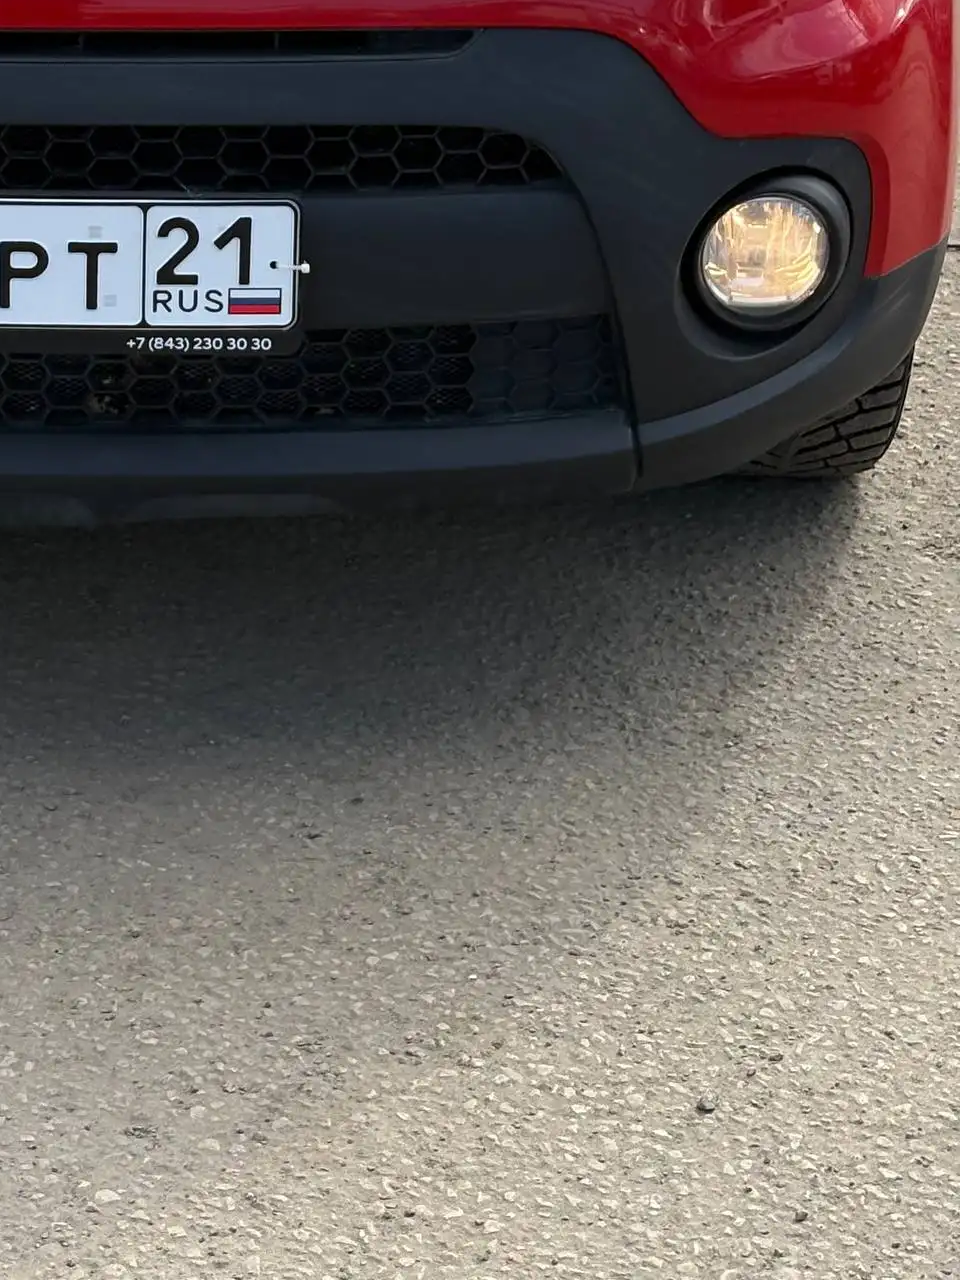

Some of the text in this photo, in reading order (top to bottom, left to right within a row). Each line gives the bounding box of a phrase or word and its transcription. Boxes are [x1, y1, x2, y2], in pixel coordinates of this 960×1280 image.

[155, 216, 253, 286] 21
[152, 289, 225, 313] RUS
[126, 337, 273, 352] +7 (843) 230 30 30
